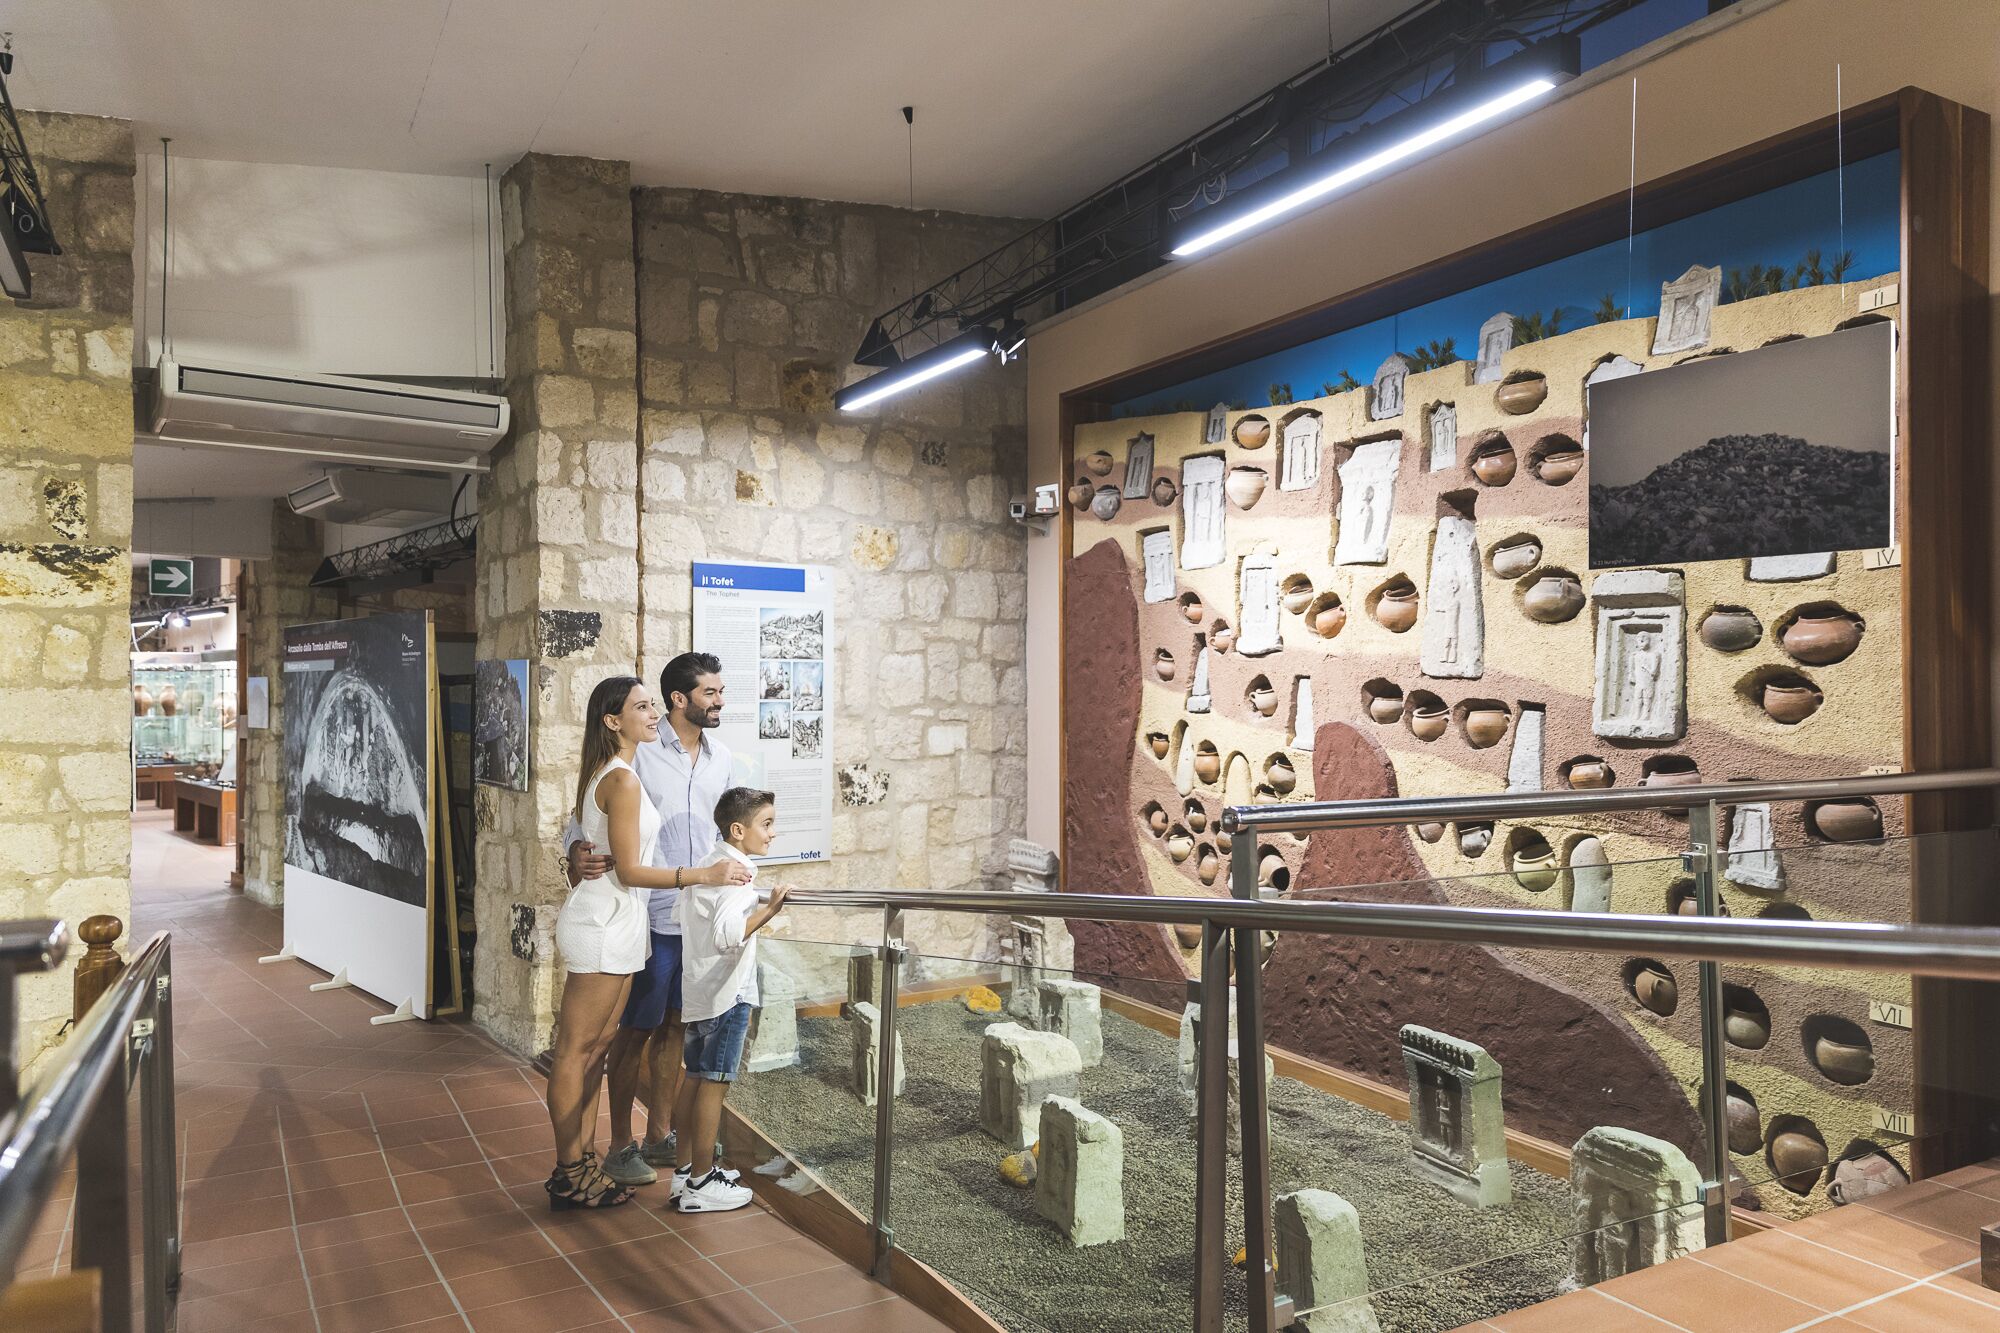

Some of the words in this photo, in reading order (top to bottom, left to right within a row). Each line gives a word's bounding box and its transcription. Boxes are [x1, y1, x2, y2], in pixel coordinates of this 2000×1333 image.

[1877, 549, 1895, 566] IV
[710, 575, 734, 587] Tofet
[719, 590, 740, 599] Tophet
[312, 642, 324, 651] Tomba
[800, 850, 821, 859] tofet
[1878, 1005, 1902, 1024] VII
[1881, 1112, 1907, 1133] VIII
